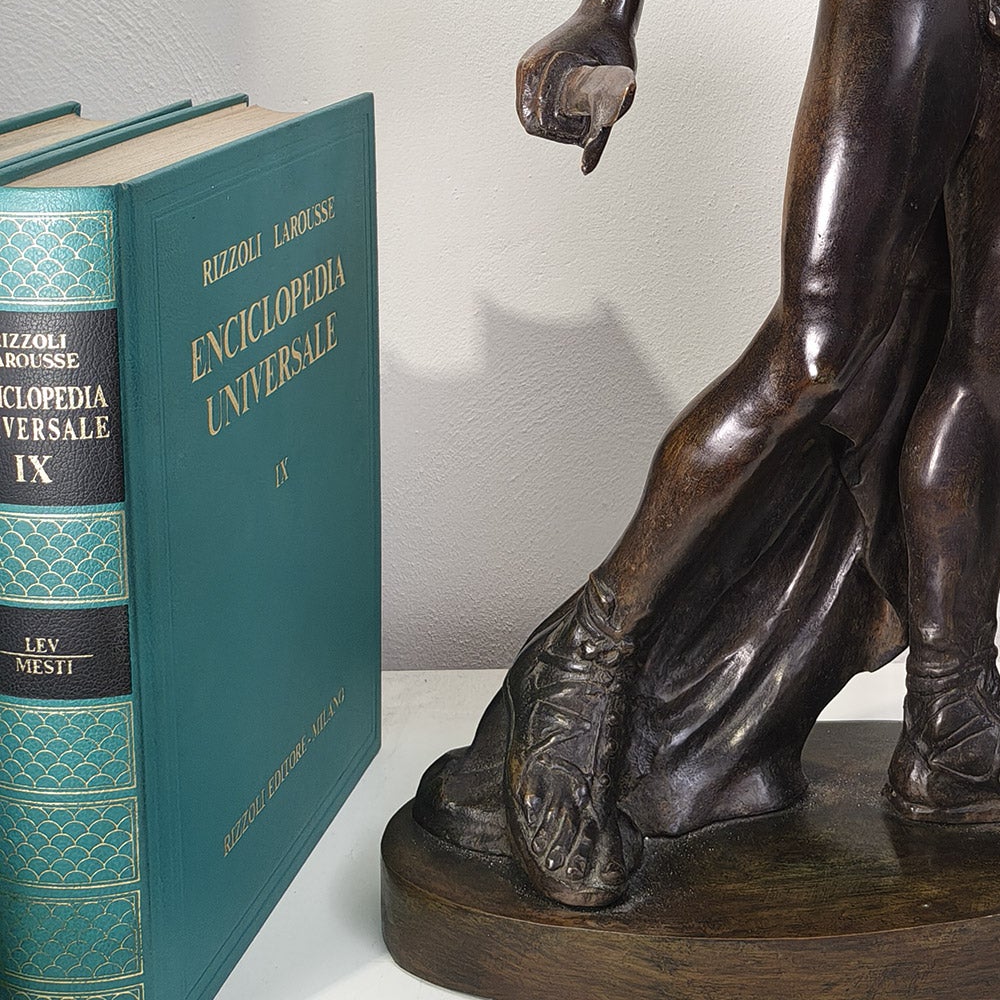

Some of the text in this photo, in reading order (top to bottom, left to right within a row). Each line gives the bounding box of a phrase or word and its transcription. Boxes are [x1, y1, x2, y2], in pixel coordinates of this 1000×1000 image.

[203, 196, 336, 288] RIZZOLI LAROUSSE
[190, 254, 346, 383] ENCICLOPEDIA
[0, 333, 67, 349] IZZOLI
[206, 312, 338, 436] UNIVERSALE
[14, 454, 53, 483] IX
[275, 456, 289, 488] IX
[25, 638, 59, 654] LEV
[16, 658, 73, 675] MESTI
[224, 788, 266, 857] RIZZOLI
